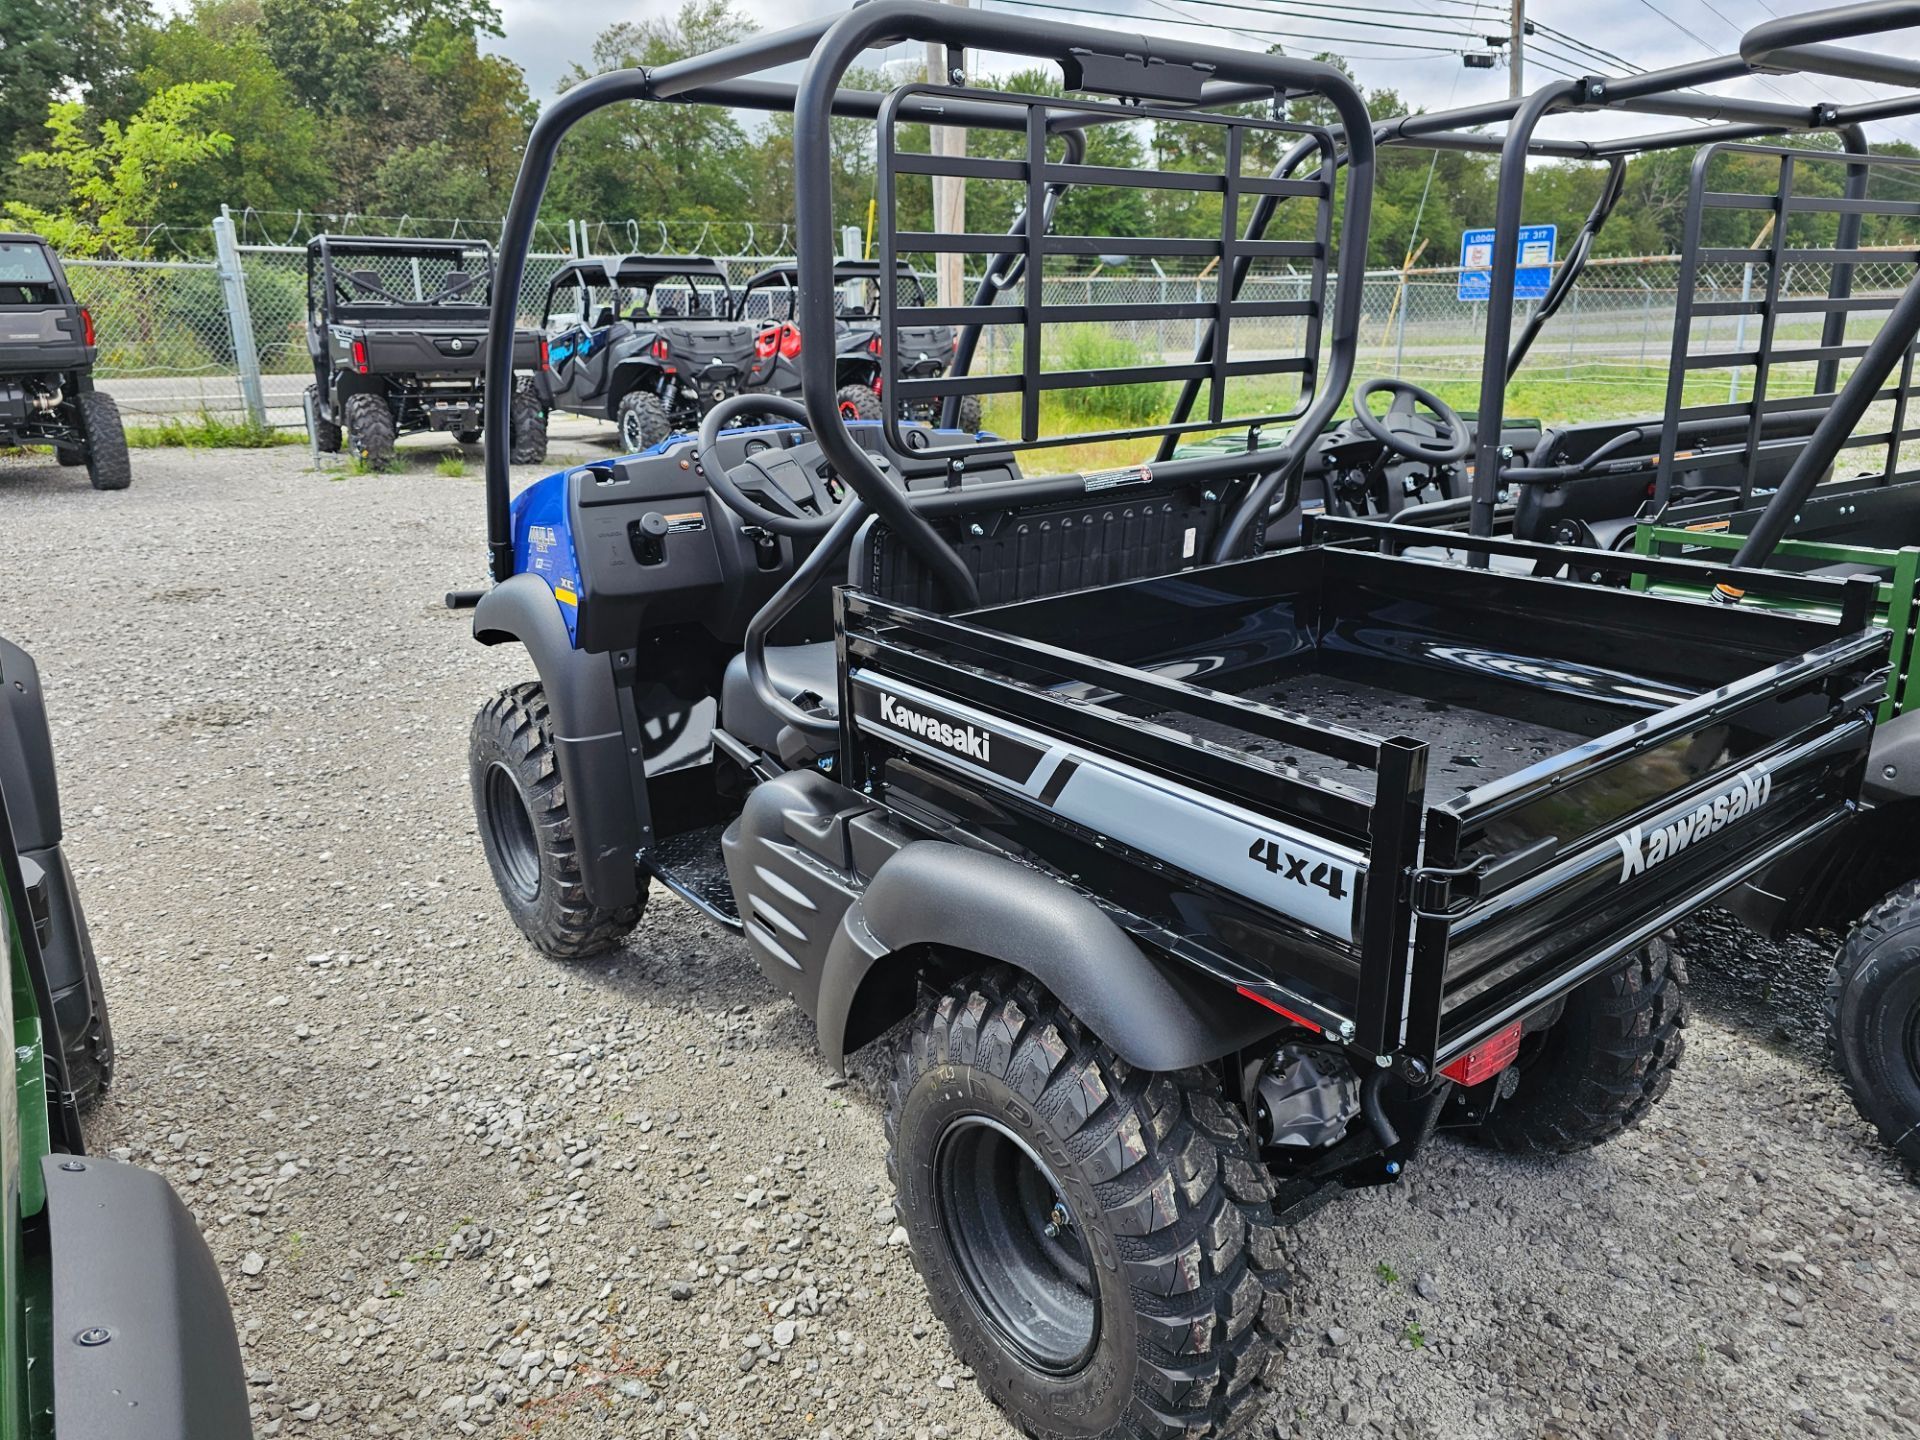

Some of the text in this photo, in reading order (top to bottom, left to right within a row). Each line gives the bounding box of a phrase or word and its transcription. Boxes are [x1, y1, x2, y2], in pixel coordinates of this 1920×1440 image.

[880, 692, 990, 762] Kawasaki
[1614, 761, 1772, 884] Kawasaki
[1249, 838, 1348, 901] 4x4
